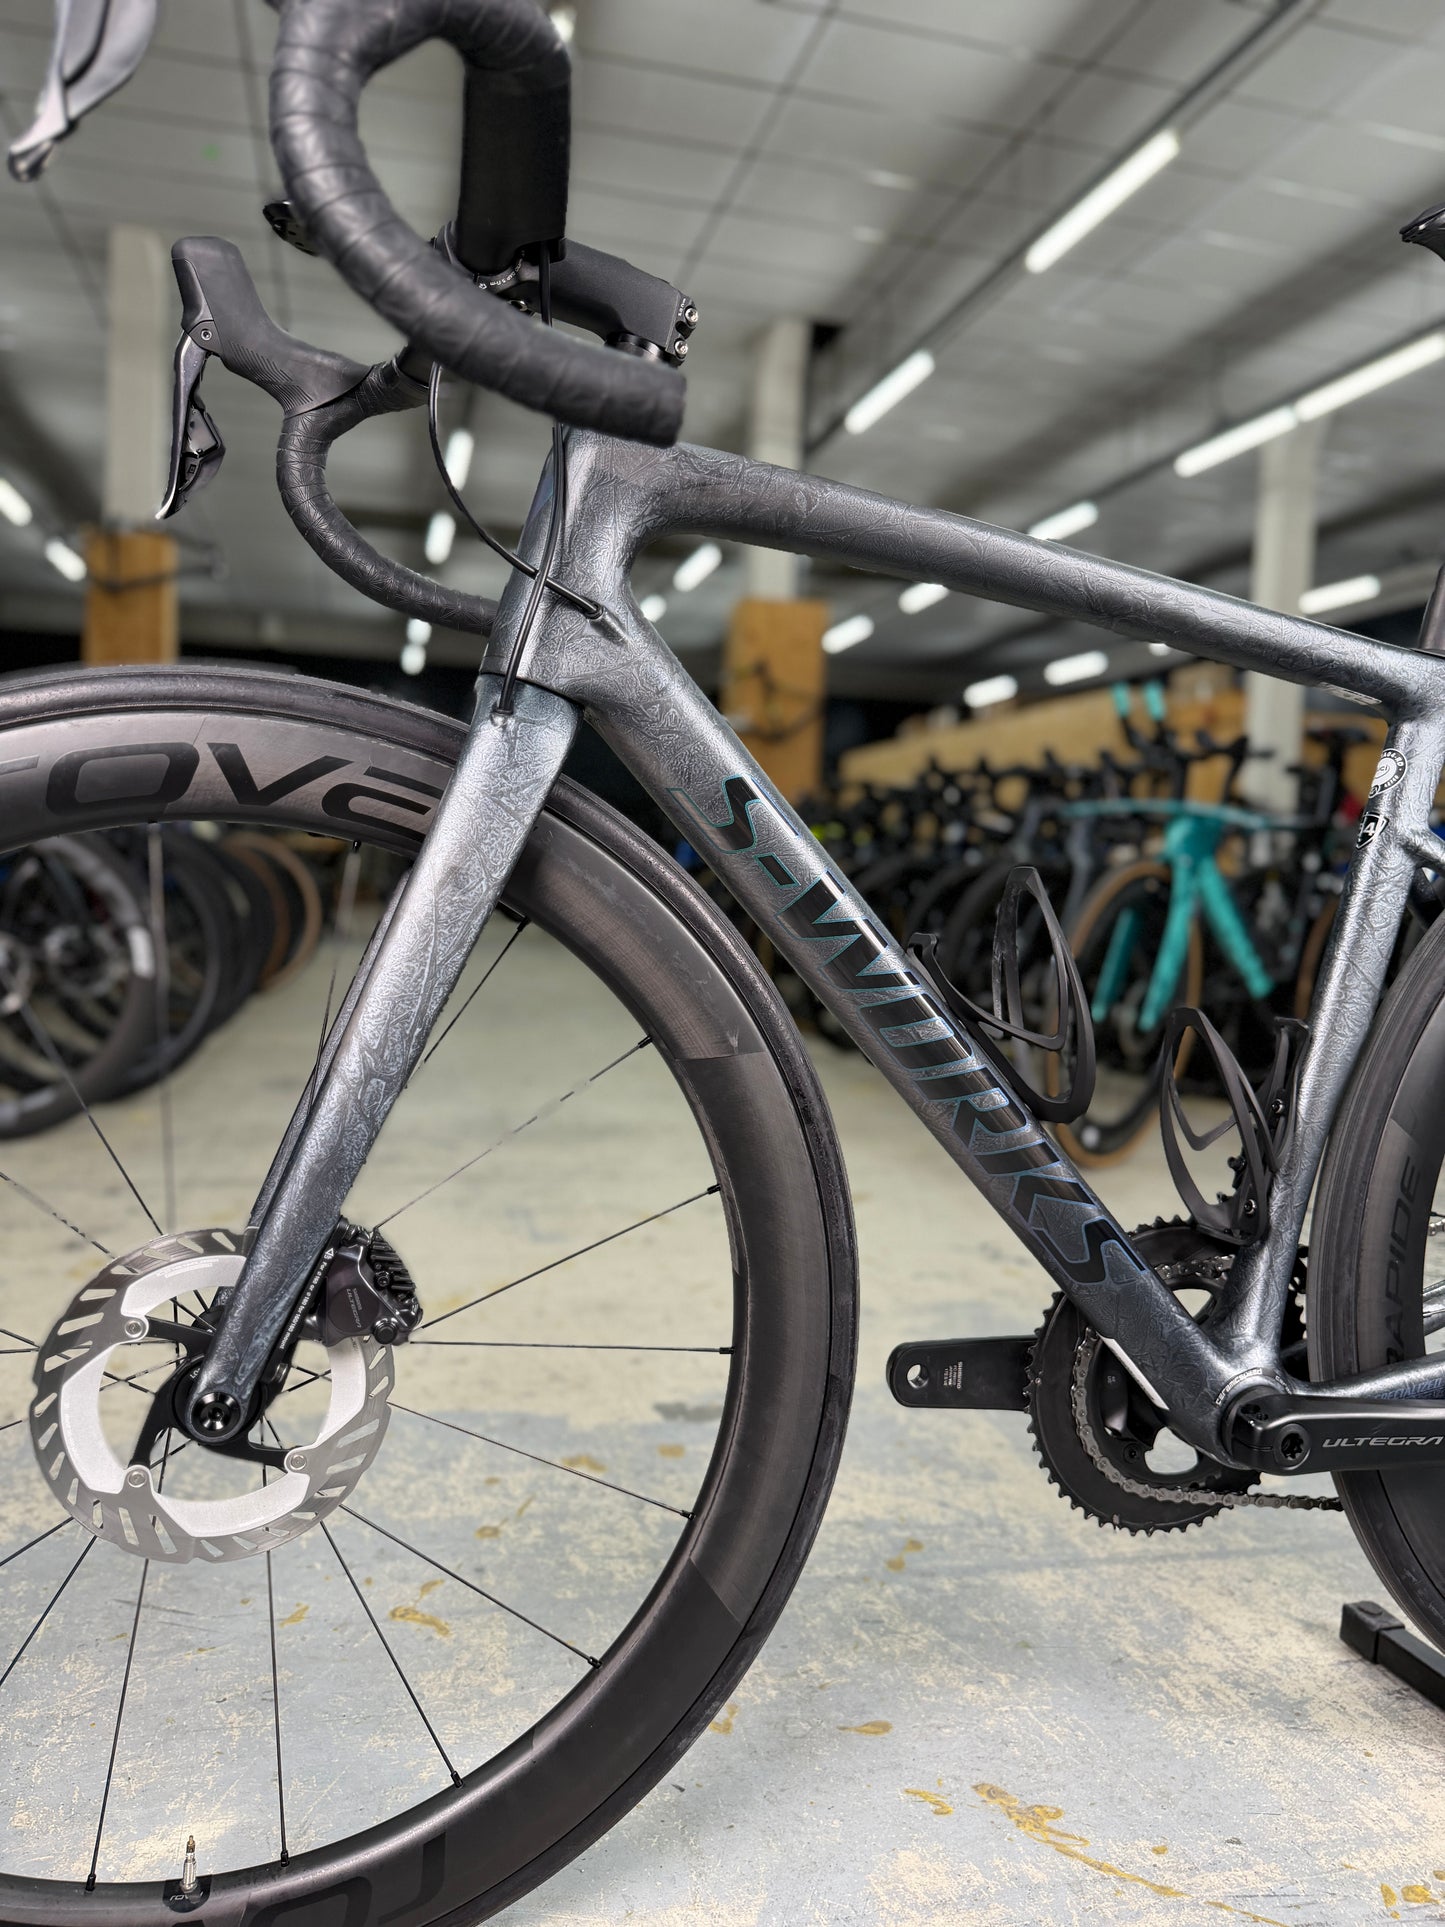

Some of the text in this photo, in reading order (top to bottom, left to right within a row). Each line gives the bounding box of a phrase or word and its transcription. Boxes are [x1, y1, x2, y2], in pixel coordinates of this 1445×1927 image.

[667, 774, 1148, 1284] S-WORKS
[346, 1288, 362, 1328] ULTEGRA
[1322, 1436, 1445, 1448] ULTEGRA
